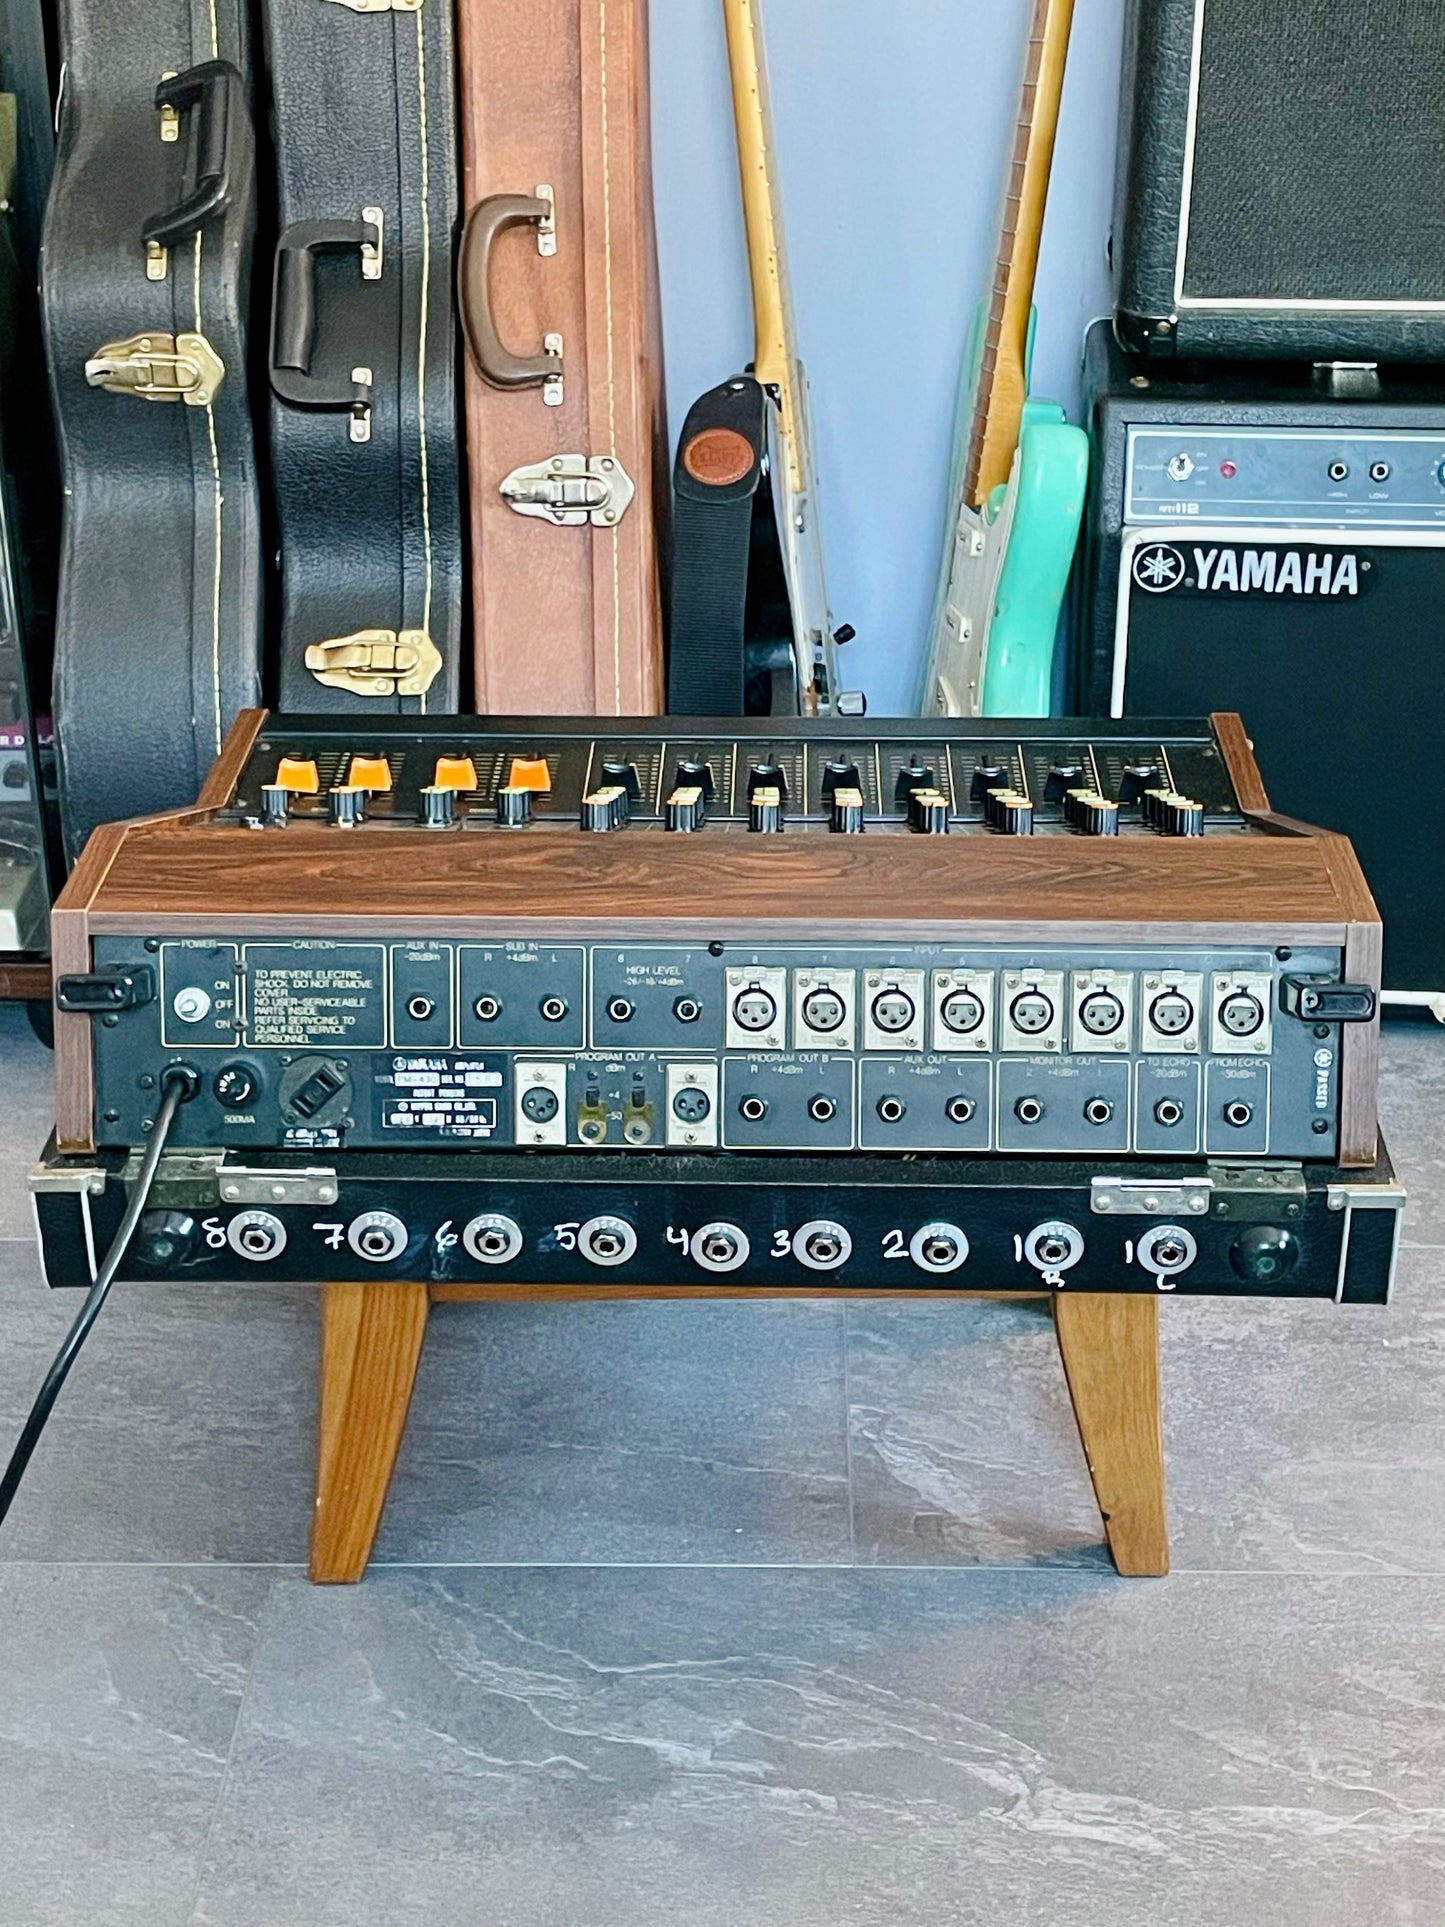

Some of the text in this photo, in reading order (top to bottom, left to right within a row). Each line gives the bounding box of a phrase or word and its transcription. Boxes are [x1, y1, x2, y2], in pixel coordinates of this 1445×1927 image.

[1193, 547, 1358, 595] YAMAHA
[291, 940, 336, 950] CAUTION
[406, 941, 439, 950] AUX IN
[505, 942, 539, 952] SUB IN
[483, 952, 493, 962] R
[551, 953, 558, 963] L
[685, 954, 692, 963] 7
[255, 970, 362, 979] TO PREVENT ELECTRIC
[626, 966, 681, 976] HIGH LEVEL
[214, 981, 230, 990] ON
[292, 980, 309, 988] DO
[310, 980, 330, 988] NOT
[332, 980, 374, 989] REMOVE
[214, 1000, 234, 1009] OFF
[254, 998, 270, 1006] NO
[254, 1006, 286, 1016] PARTS
[214, 1020, 231, 1029] ON
[254, 1015, 357, 1026] REFER SERVICING TO
[254, 1024, 347, 1035] QUALIFIED SERVICE
[574, 1052, 657, 1062] PROGRAM OUT A
[747, 1053, 830, 1063] PROGRAM OUT B
[903, 1055, 948, 1065] AUX OUT
[1029, 1056, 1098, 1066] MONITOR OUT
[1147, 1057, 1191, 1068] TO ECHO
[568, 1063, 576, 1071] R
[657, 1063, 665, 1073] L
[750, 1064, 759, 1073] R
[819, 1065, 825, 1075] L
[887, 1065, 896, 1075] R
[957, 1067, 964, 1076] L
[1315, 1069, 1330, 1109] PASSED
[223, 1114, 256, 1124] 500MA
[201, 1217, 227, 1248] 8
[312, 1223, 345, 1250] 7
[434, 1220, 459, 1253] 6
[553, 1222, 581, 1250] 5
[666, 1226, 689, 1256] 4
[770, 1229, 791, 1258] 3
[882, 1229, 910, 1259] 2
[1013, 1234, 1023, 1263] 1
[1125, 1240, 1134, 1264] 1
